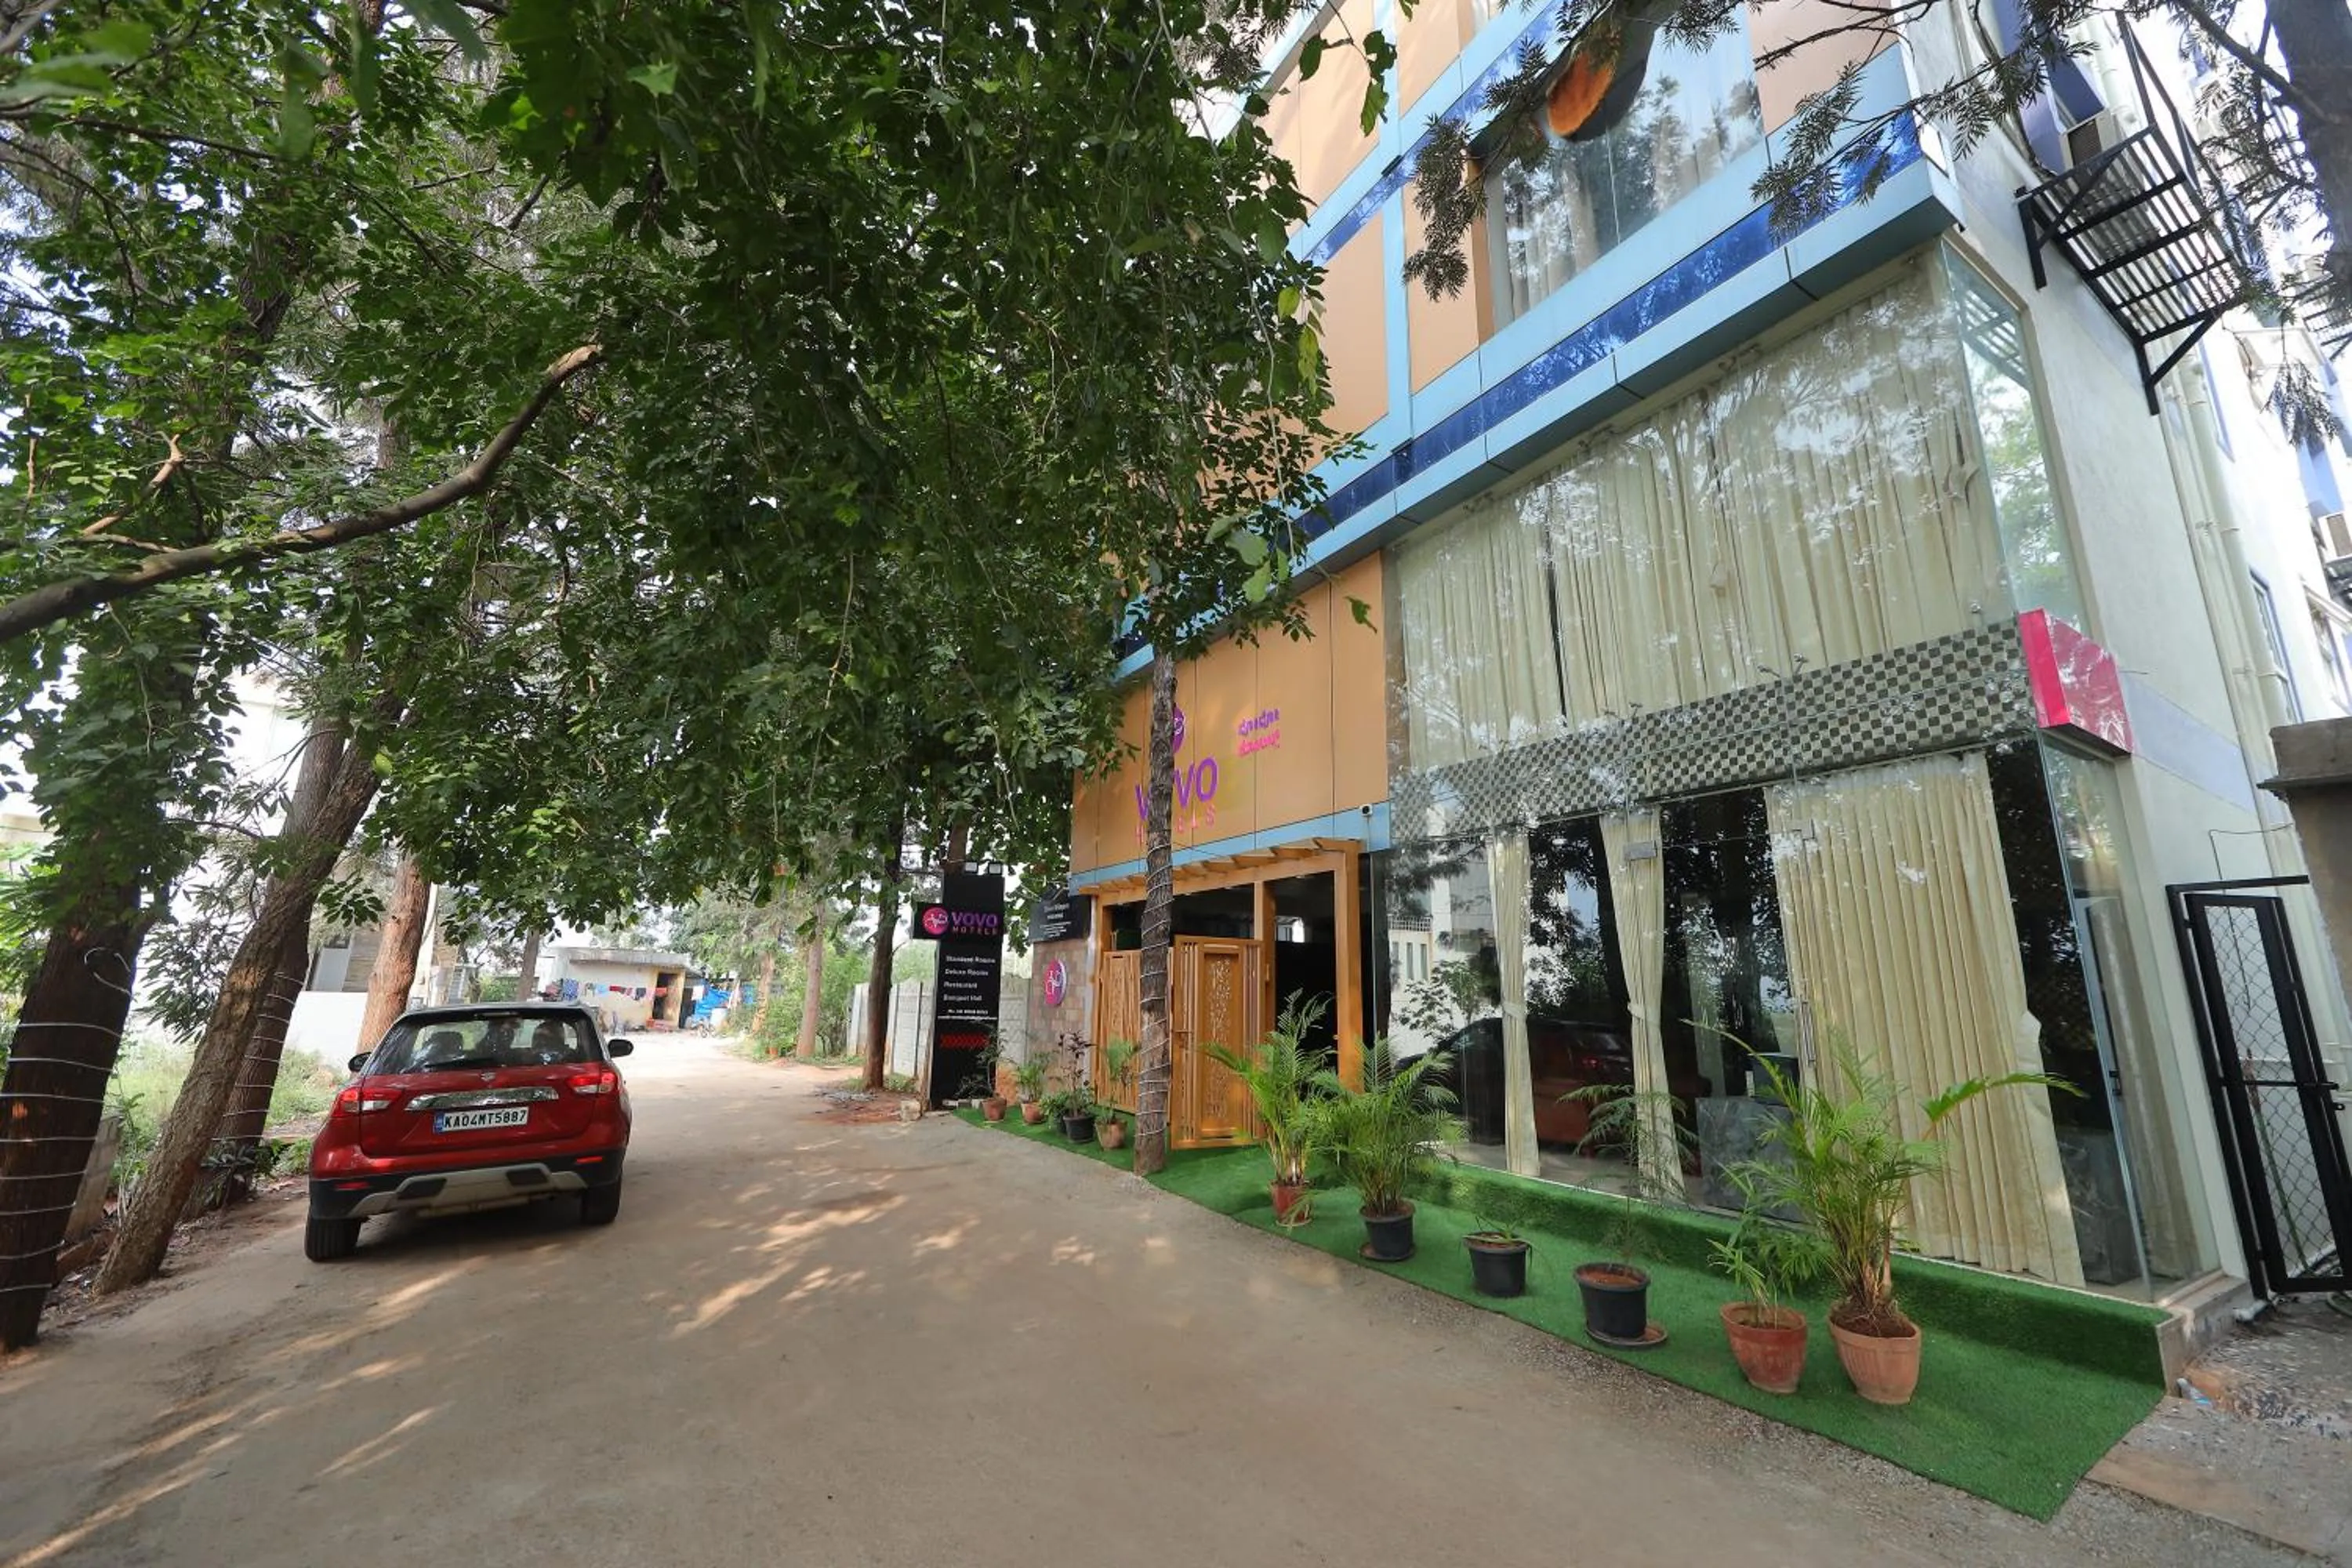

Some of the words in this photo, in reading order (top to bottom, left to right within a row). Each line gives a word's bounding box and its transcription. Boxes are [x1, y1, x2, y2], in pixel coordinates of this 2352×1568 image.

[1135, 758, 1218, 822] VVO
[1135, 804, 1215, 846] HELS
[951, 912, 997, 927] VOVO
[953, 927, 997, 935] HOTELS
[444, 1109, 526, 1128] KA04MT5887
